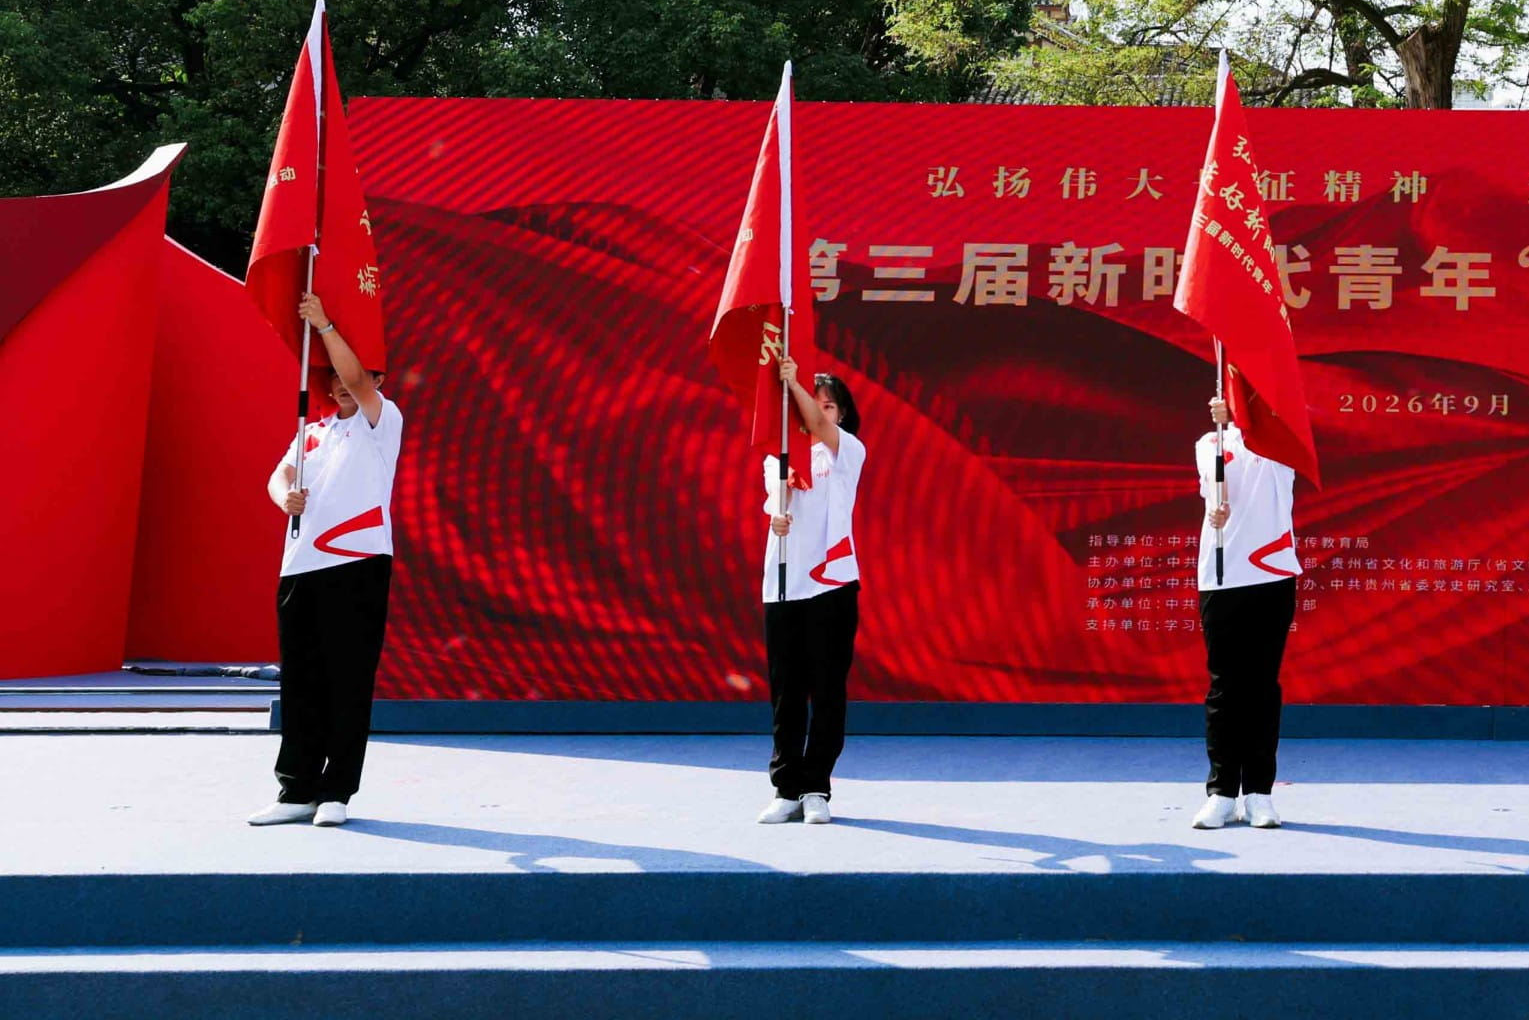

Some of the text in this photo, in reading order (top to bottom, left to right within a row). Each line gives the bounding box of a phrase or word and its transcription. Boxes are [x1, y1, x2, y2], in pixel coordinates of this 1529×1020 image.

[927, 166, 1428, 204] 弘扬伟大征精神
[1339, 393, 1509, 416] 2026年9月
[1088, 534, 1369, 549] 指导单位：中共传教育局
[1087, 597, 1317, 611] 承办单位：中共部
